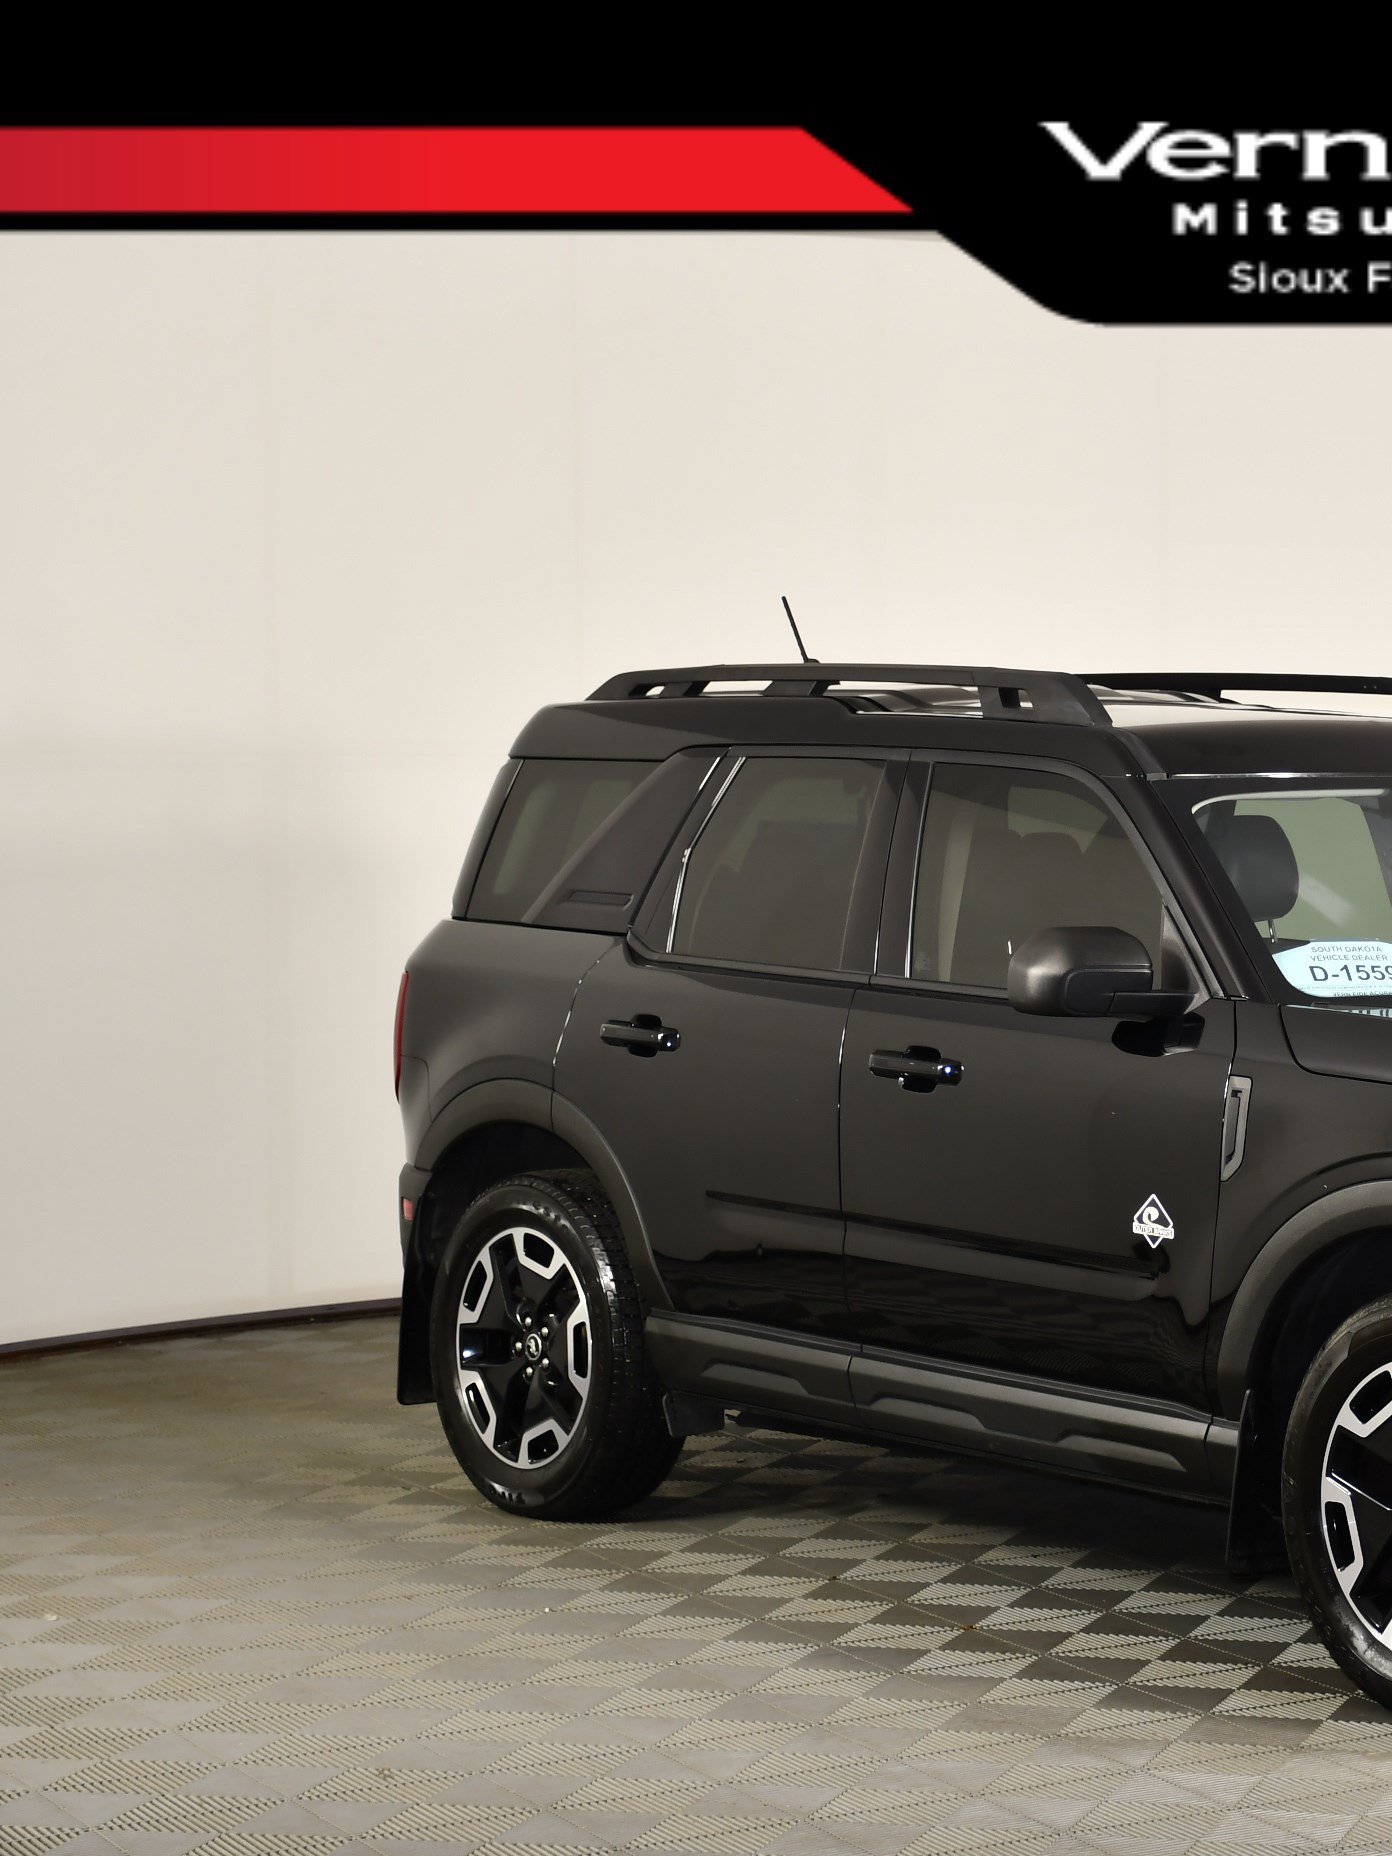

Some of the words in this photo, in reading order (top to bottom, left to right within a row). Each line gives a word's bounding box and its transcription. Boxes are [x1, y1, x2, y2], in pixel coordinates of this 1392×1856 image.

[1310, 945, 1343, 953] SOUTH
[1344, 945, 1383, 953] DAKOTA
[1310, 954, 1351, 962] VEHICLE
[1351, 954, 1389, 962] DEALER
